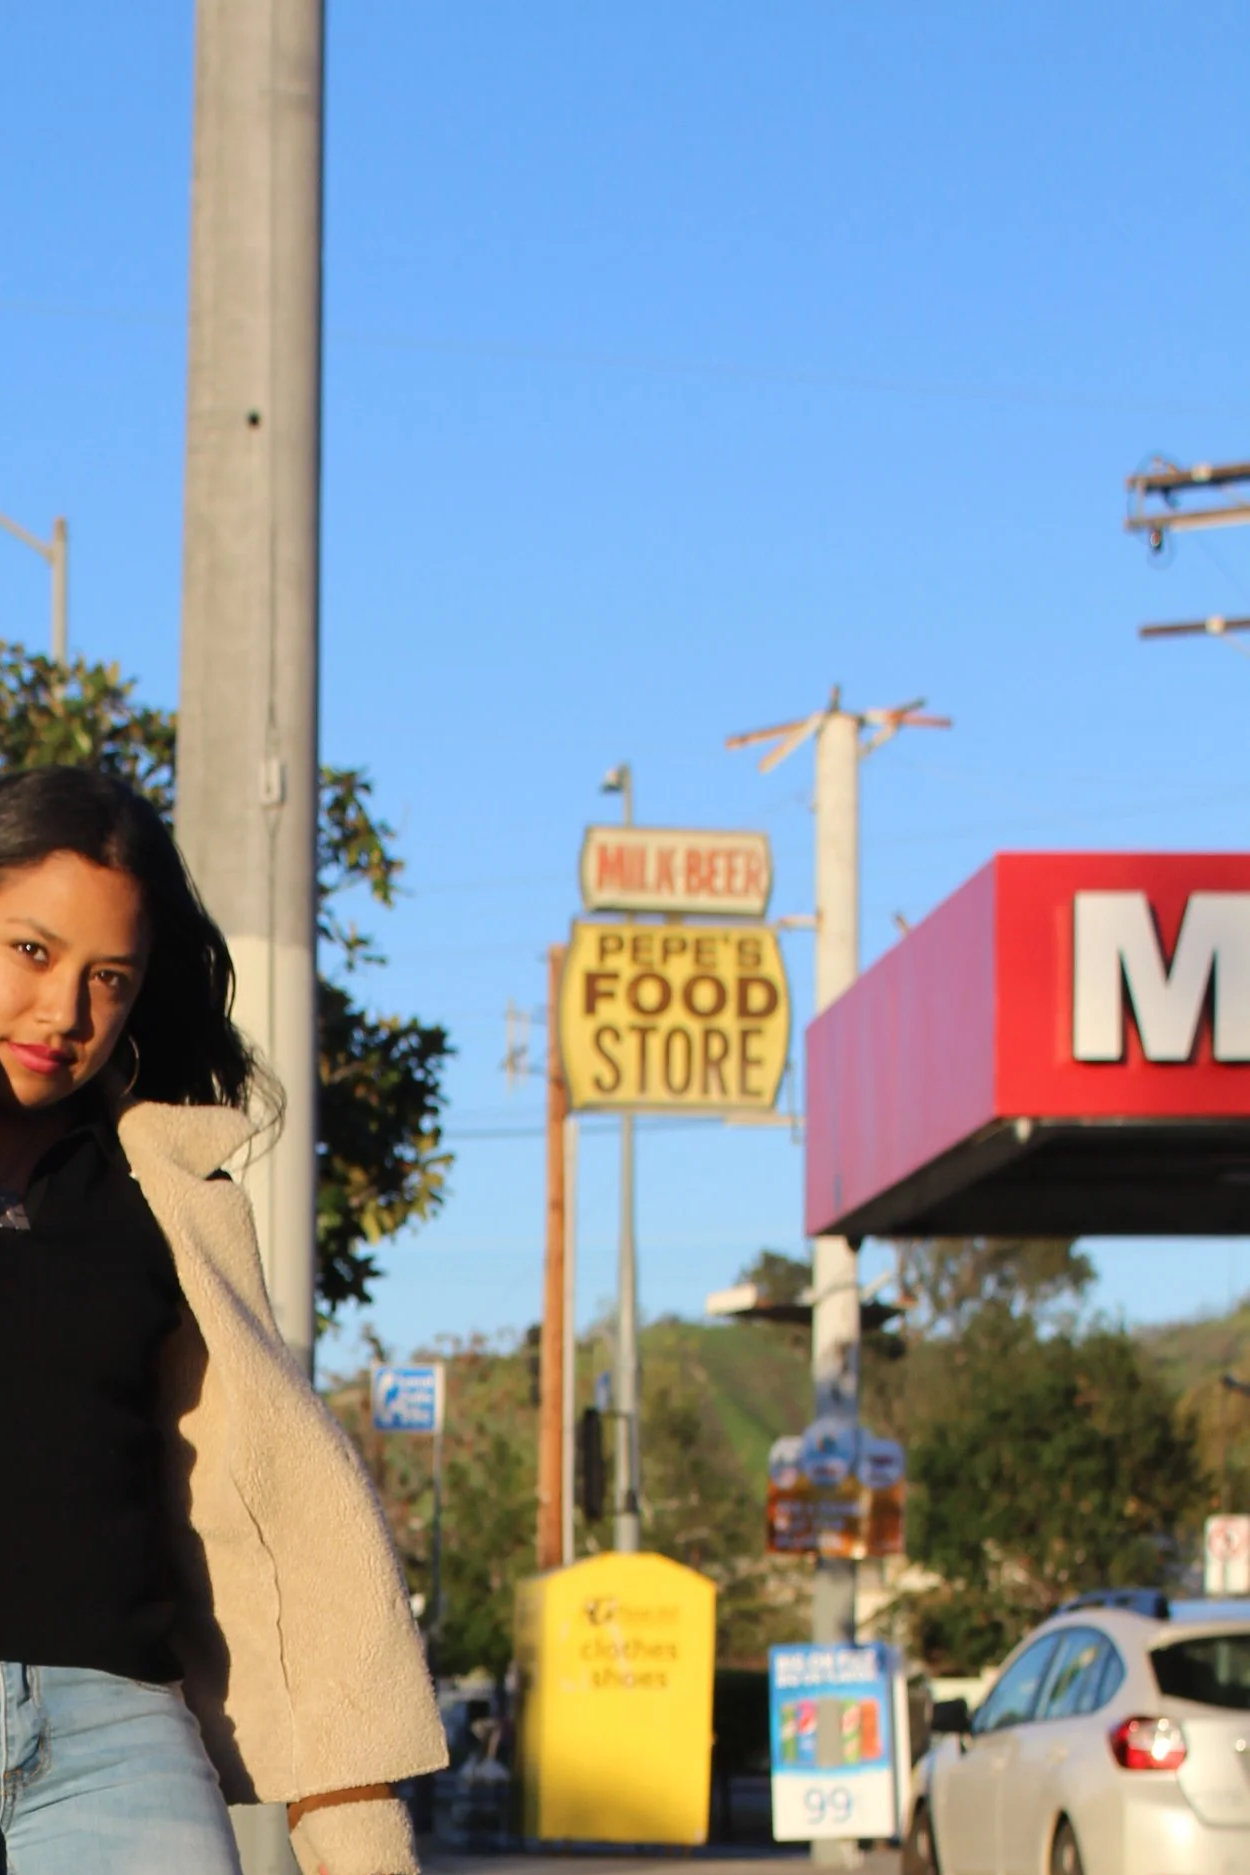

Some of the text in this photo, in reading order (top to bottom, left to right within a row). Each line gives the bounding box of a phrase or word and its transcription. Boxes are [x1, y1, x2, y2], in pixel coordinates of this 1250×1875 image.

[596, 844, 763, 899] MILK BEER
[598, 934, 762, 970] PEPE'S
[584, 973, 777, 1018] FOOD
[594, 1026, 763, 1096] STORE
[805, 1788, 853, 1825] 99
